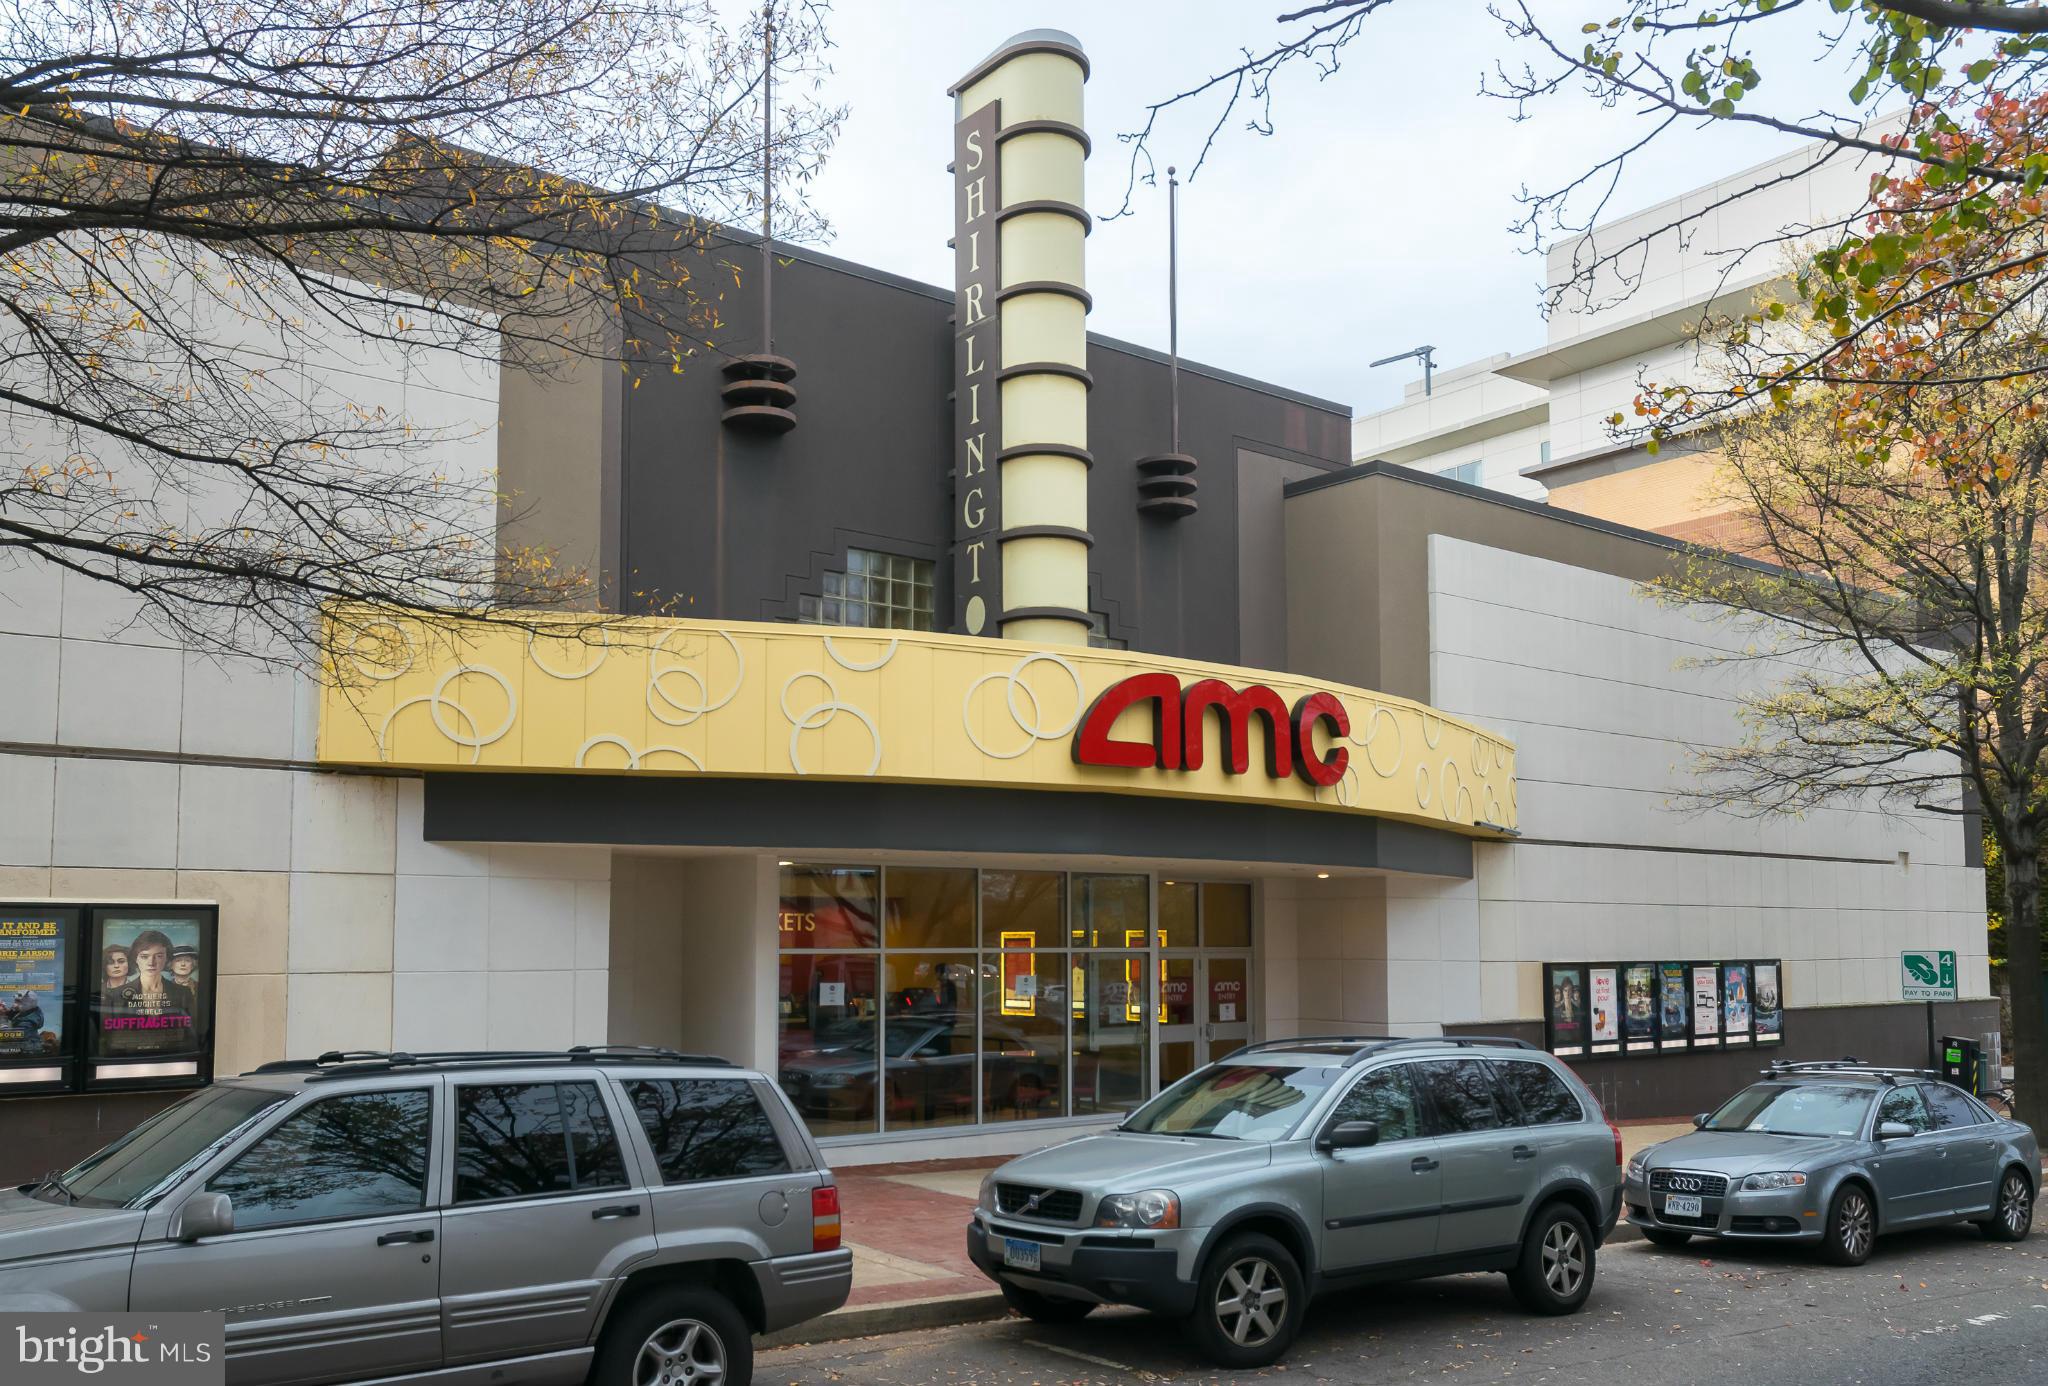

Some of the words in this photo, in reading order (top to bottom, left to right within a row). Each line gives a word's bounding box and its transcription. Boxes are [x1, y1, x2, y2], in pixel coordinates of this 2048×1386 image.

[1071, 672, 1351, 787] amc
[1940, 954, 1953, 967] 4
[1214, 981, 1241, 992] amc
[132, 992, 167, 1000] MOTHERS
[128, 1000, 171, 1008] DAUGHTERS
[104, 1016, 192, 1030] SUFFRAGETTE
